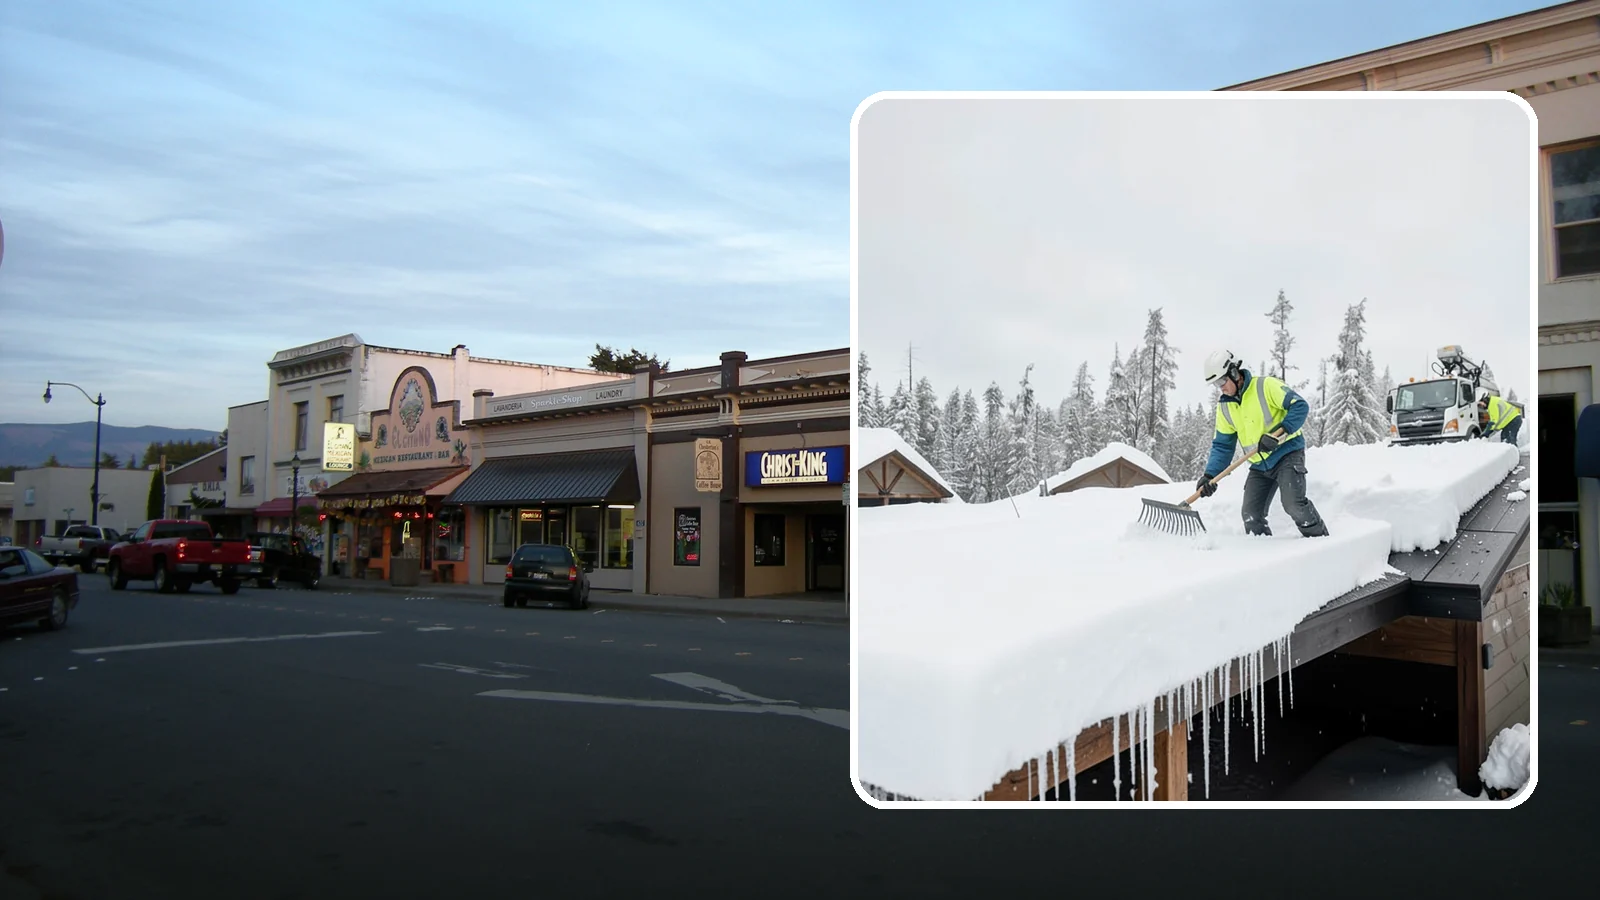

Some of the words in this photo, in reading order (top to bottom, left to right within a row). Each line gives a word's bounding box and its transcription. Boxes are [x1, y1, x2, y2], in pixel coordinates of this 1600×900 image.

[595, 389, 624, 400] LAUNDRY
[493, 402, 522, 412] LAVANDERIA
[531, 397, 561, 409] Sparkle
[561, 394, 582, 405] Shop
[373, 454, 396, 464] MEXICAN
[397, 451, 433, 462] RESTAURANT
[437, 450, 450, 459] BAR
[760, 452, 797, 478] CHRIST
[799, 450, 827, 476] KING
[696, 481, 709, 489] Coffee
[710, 481, 722, 489] House
